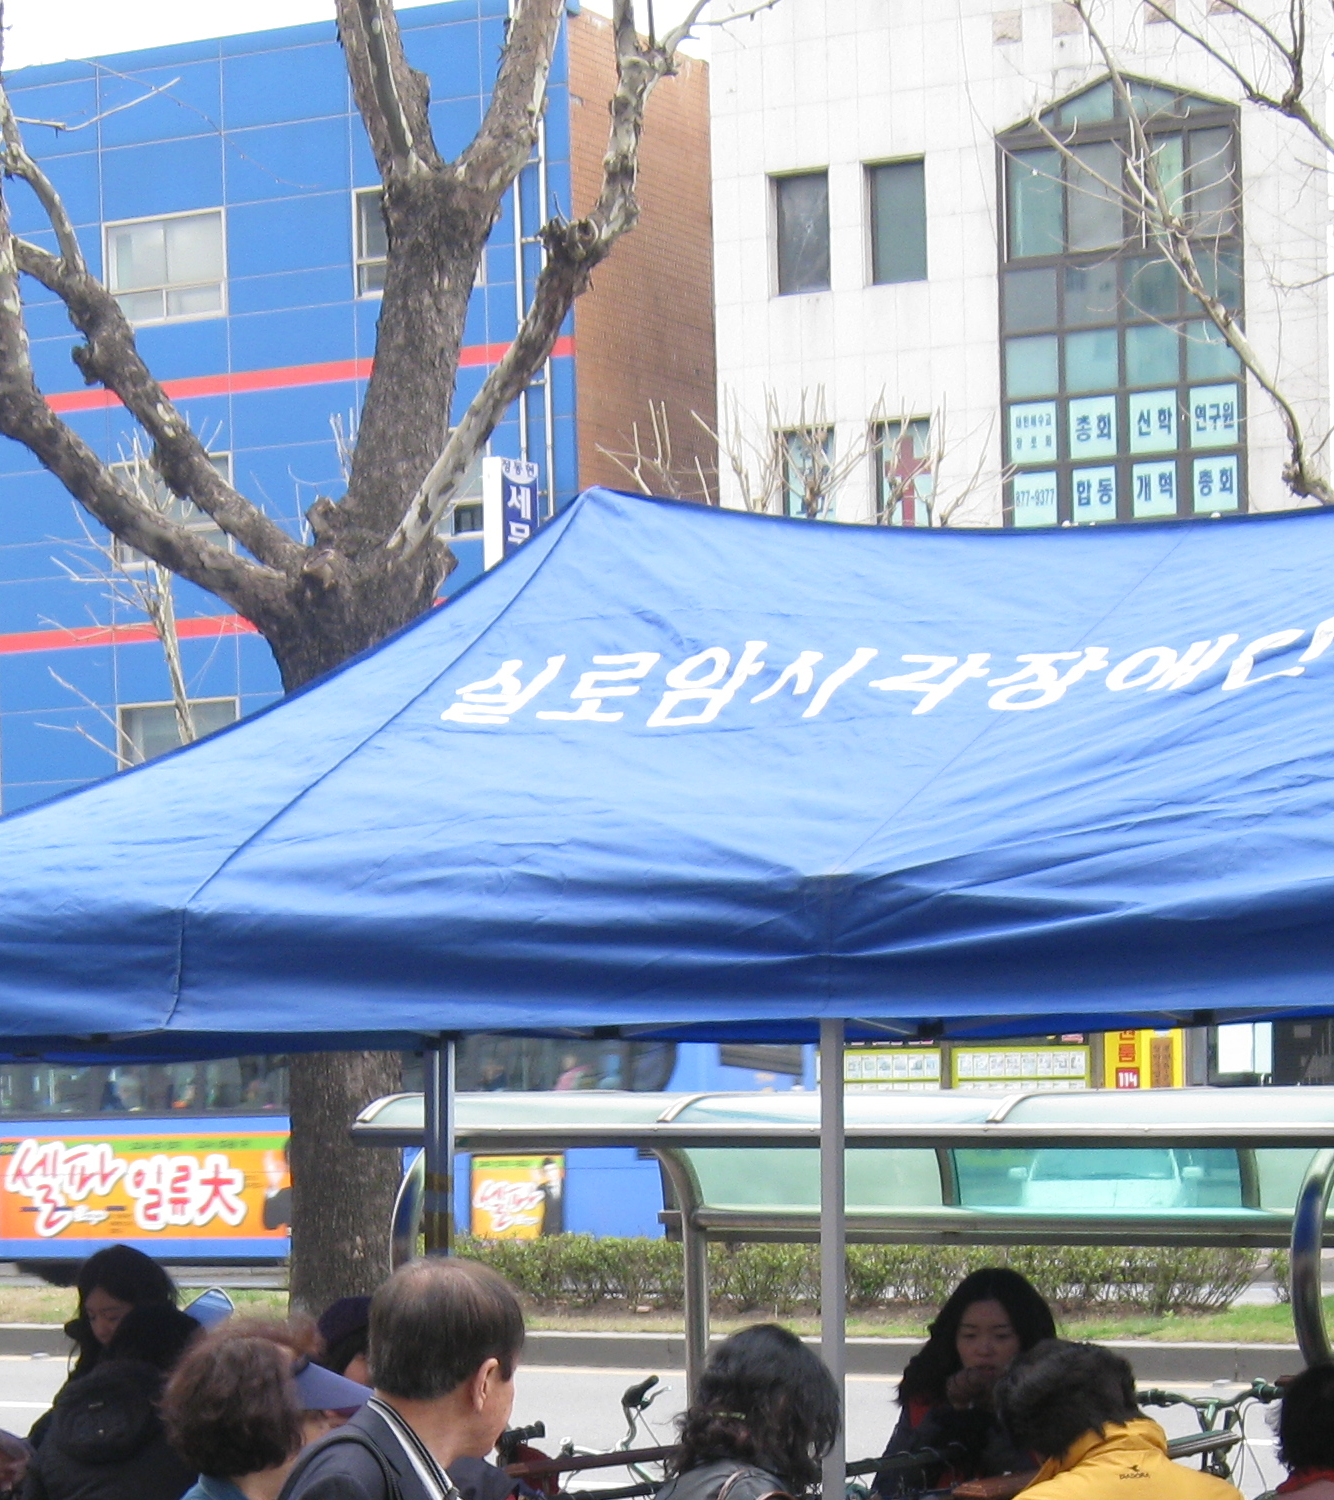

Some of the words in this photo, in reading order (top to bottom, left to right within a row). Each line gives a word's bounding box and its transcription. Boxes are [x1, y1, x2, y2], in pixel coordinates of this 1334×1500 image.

[1075, 411, 1112, 442] 총회
[1137, 406, 1173, 437] 신학
[1194, 400, 1235, 432] 연구원
[1076, 477, 1114, 507] 합동
[1136, 470, 1174, 502] 개혁
[1198, 466, 1234, 498] 총회
[1119, 1071, 1138, 1087] 114
